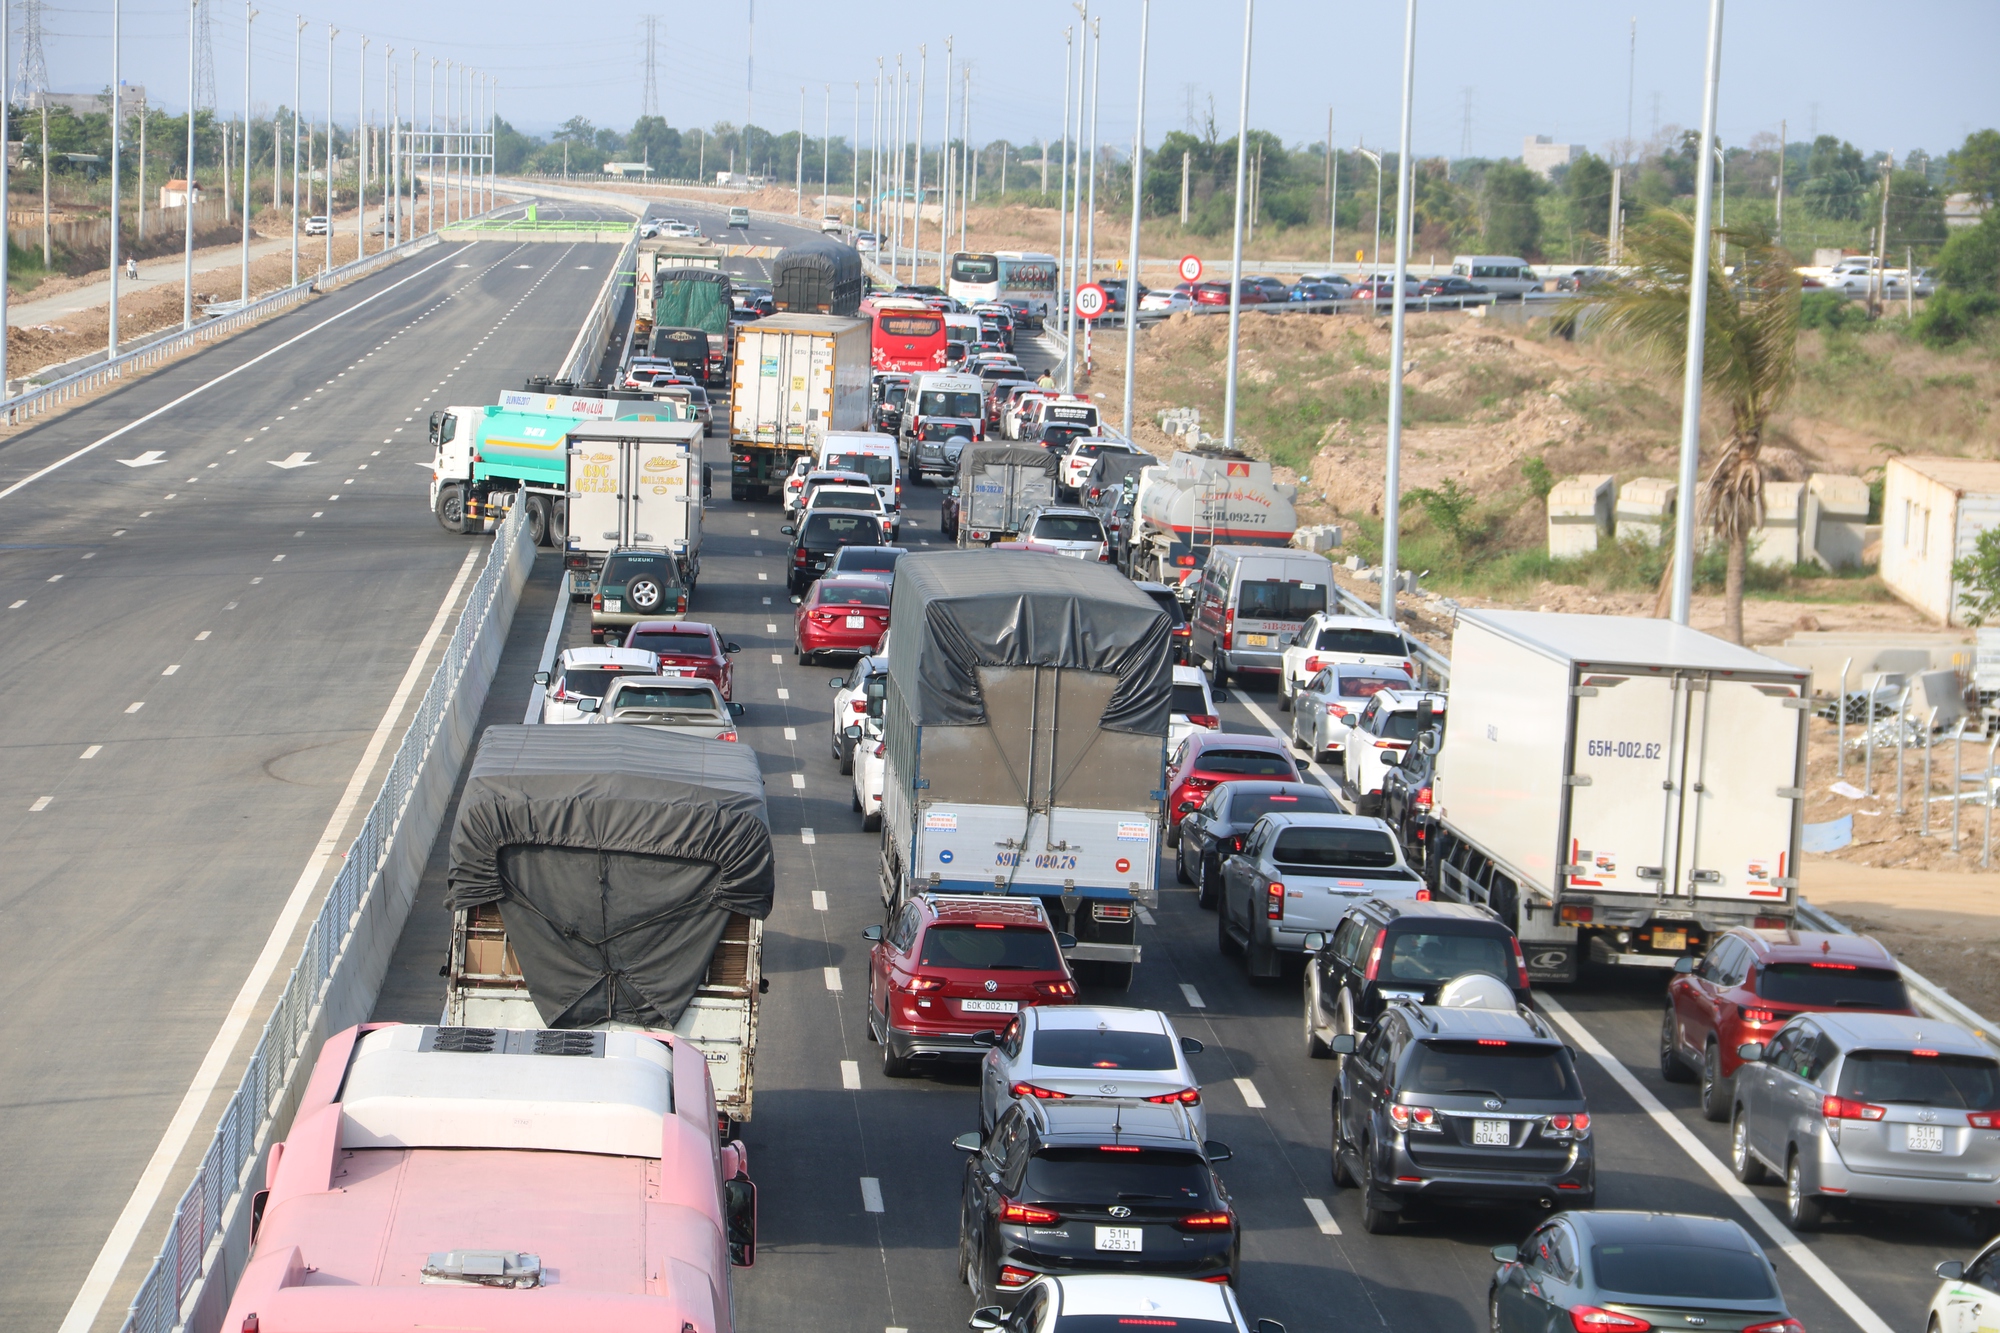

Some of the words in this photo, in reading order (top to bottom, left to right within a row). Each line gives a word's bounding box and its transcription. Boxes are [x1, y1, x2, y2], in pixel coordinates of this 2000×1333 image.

[1186, 263, 1196, 274] 40
[1082, 294, 1097, 309] 60
[583, 465, 609, 478] 69C
[575, 478, 617, 492] 057.55
[1262, 622, 1303, 632] 51B-276.9
[1588, 740, 1662, 760] 65H-002.62
[995, 852, 1020, 867] 89H
[1035, 854, 1078, 870] 020.78
[966, 1001, 1014, 1011] 60K-002.17
[1482, 1121, 1501, 1132] 51F
[1916, 1126, 1936, 1138] 51H
[1476, 1132, 1509, 1144] 604.30
[1909, 1138, 1942, 1150] 233.79
[1109, 1228, 1130, 1239] 51H
[1101, 1239, 1136, 1250] 425.31
